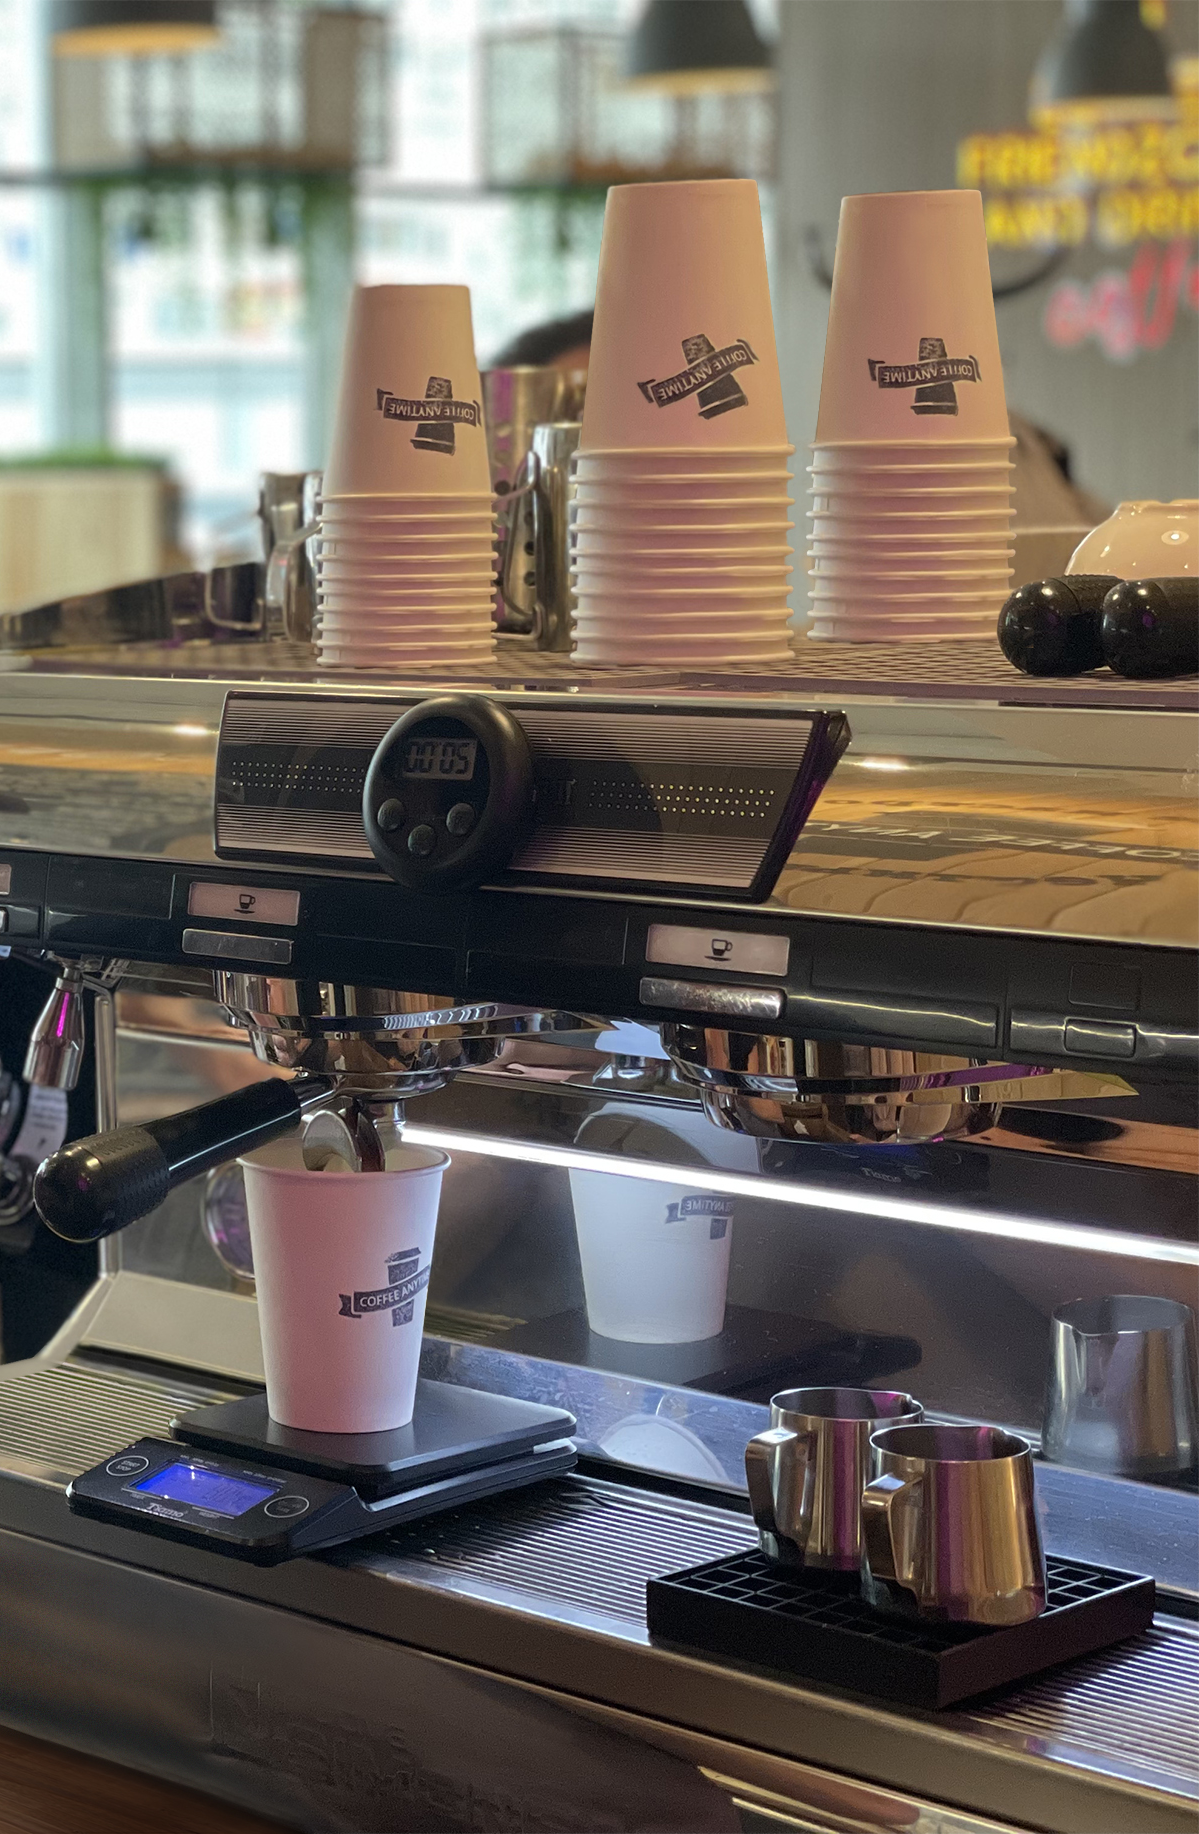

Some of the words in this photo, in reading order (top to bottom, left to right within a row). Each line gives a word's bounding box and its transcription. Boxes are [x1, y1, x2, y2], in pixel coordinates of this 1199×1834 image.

[657, 364, 713, 400] ANYTIME
[882, 367, 938, 383] ANYTIME
[388, 403, 441, 417] ANYTIME
[359, 1289, 400, 1307] COFFEE
